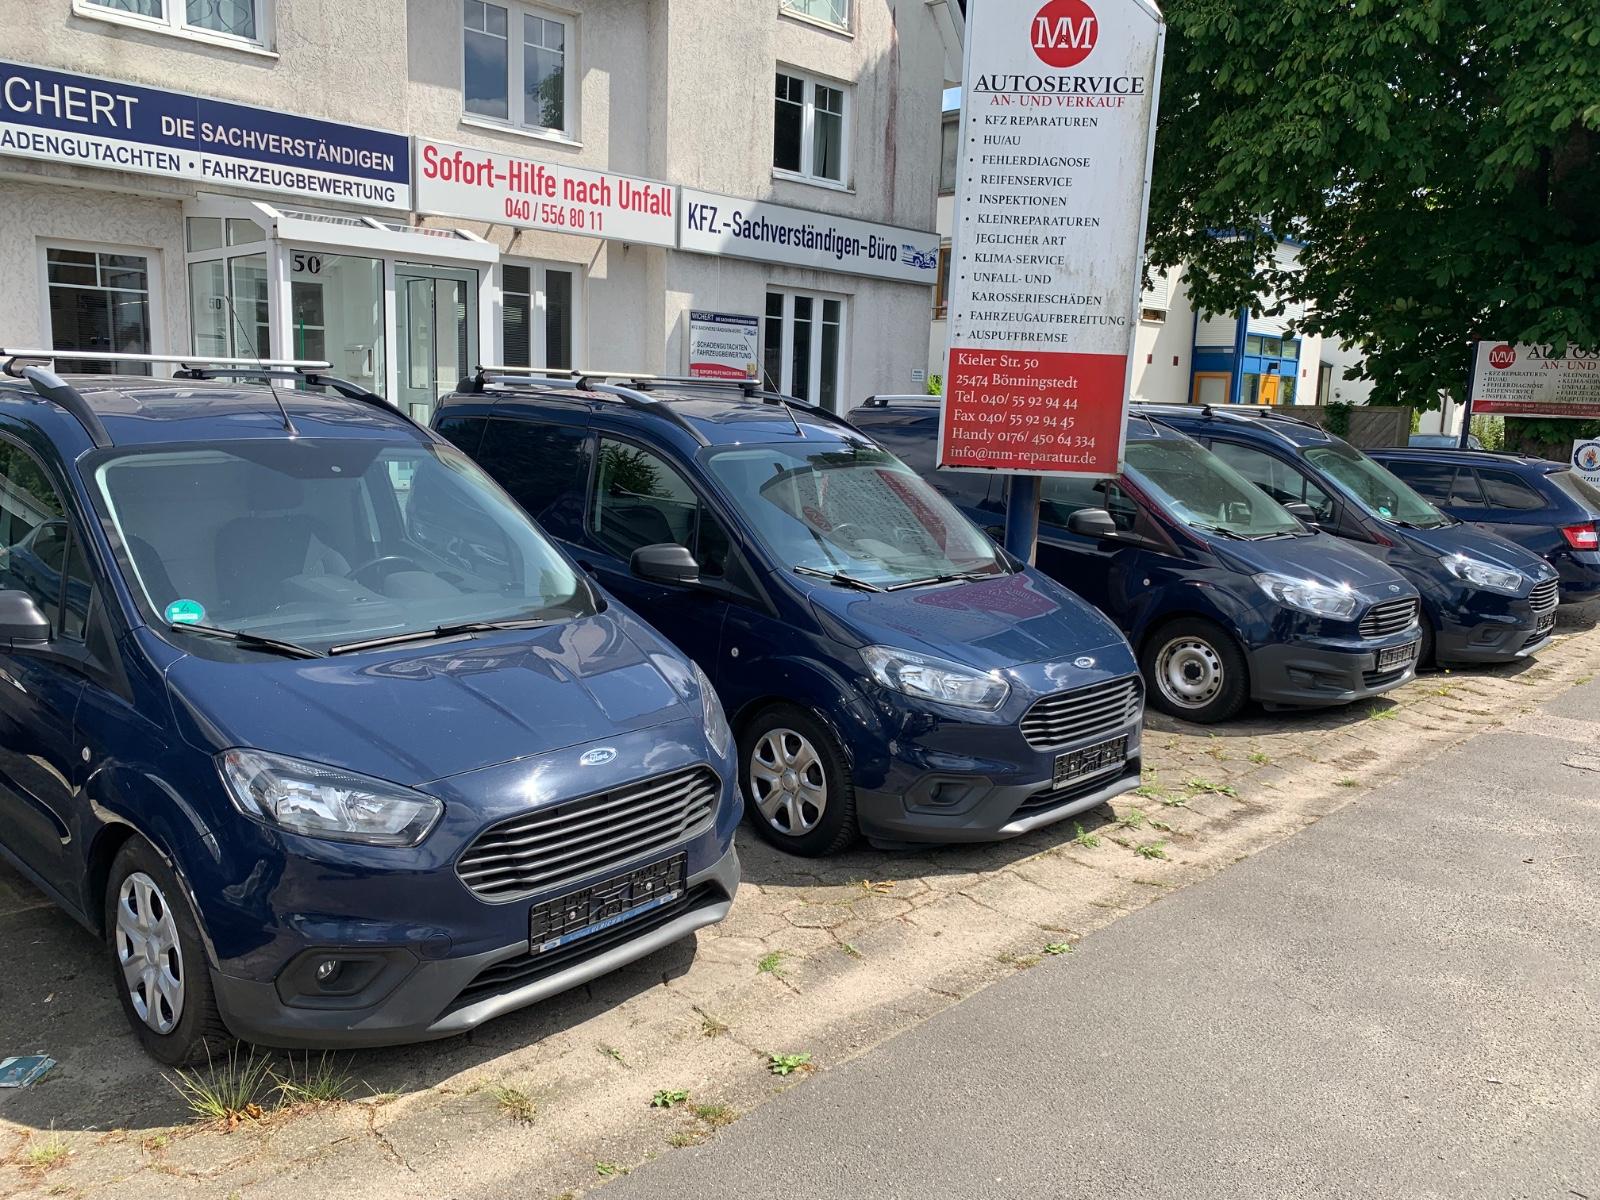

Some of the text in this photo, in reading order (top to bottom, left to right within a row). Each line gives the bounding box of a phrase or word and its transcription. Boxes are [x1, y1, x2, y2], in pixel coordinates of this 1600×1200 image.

[973, 74, 1144, 94] AUTOSERVICE
[990, 94, 1126, 108] AN- UND VERKAUF
[0, 76, 394, 172] CHERT DIE SACHVERSTÄNDIGEN
[984, 115, 1098, 127] KFZ REPARATUREN
[983, 135, 1021, 146] HU/AU
[0, 129, 396, 202] ADENGUTACHTEN FAHRZEUGBEWERTUNG
[982, 155, 1090, 168] FEHLERDIAGNOSE
[423, 144, 672, 217] Sofort-Hilfe nach Unfall
[980, 174, 1072, 187] REIFENSERVICE
[978, 194, 1068, 206] INSPEKTIONEN
[504, 198, 602, 231] 040 / 556 80 11
[977, 214, 1100, 228] KLEINREPARATUREN
[688, 202, 897, 262] KFZ.-Sachverständigen-Büro
[975, 234, 1067, 246] JEGLICHER ART
[292, 254, 321, 274] 50
[974, 252, 1065, 266] KLIMA-SERVICE
[972, 272, 1052, 284] UNFALL- UND
[972, 292, 1102, 306] KAROSSERIESCHÄDEN
[970, 310, 1126, 326] FAHRZEUGAUFBEREITUNG
[968, 330, 1068, 343] AUSPUFFBREMSE
[696, 340, 748, 351] SCHADENGUTACHTEN
[696, 349, 752, 360] FAHRZEUGBEWERTUNG
[958, 353, 1039, 370] Kieler Str. 50
[1540, 361, 1596, 370] AN- UND
[956, 373, 1078, 390] 25474 Bönningstedt
[954, 390, 1078, 410] Tel. 040/ 55 92 94 44
[954, 408, 1075, 430] Fax 040/ 55 92 94 45
[952, 428, 1096, 448] Handy 0176/ 450 64 334
[950, 446, 1097, 465] info@mm-reparatur.de
